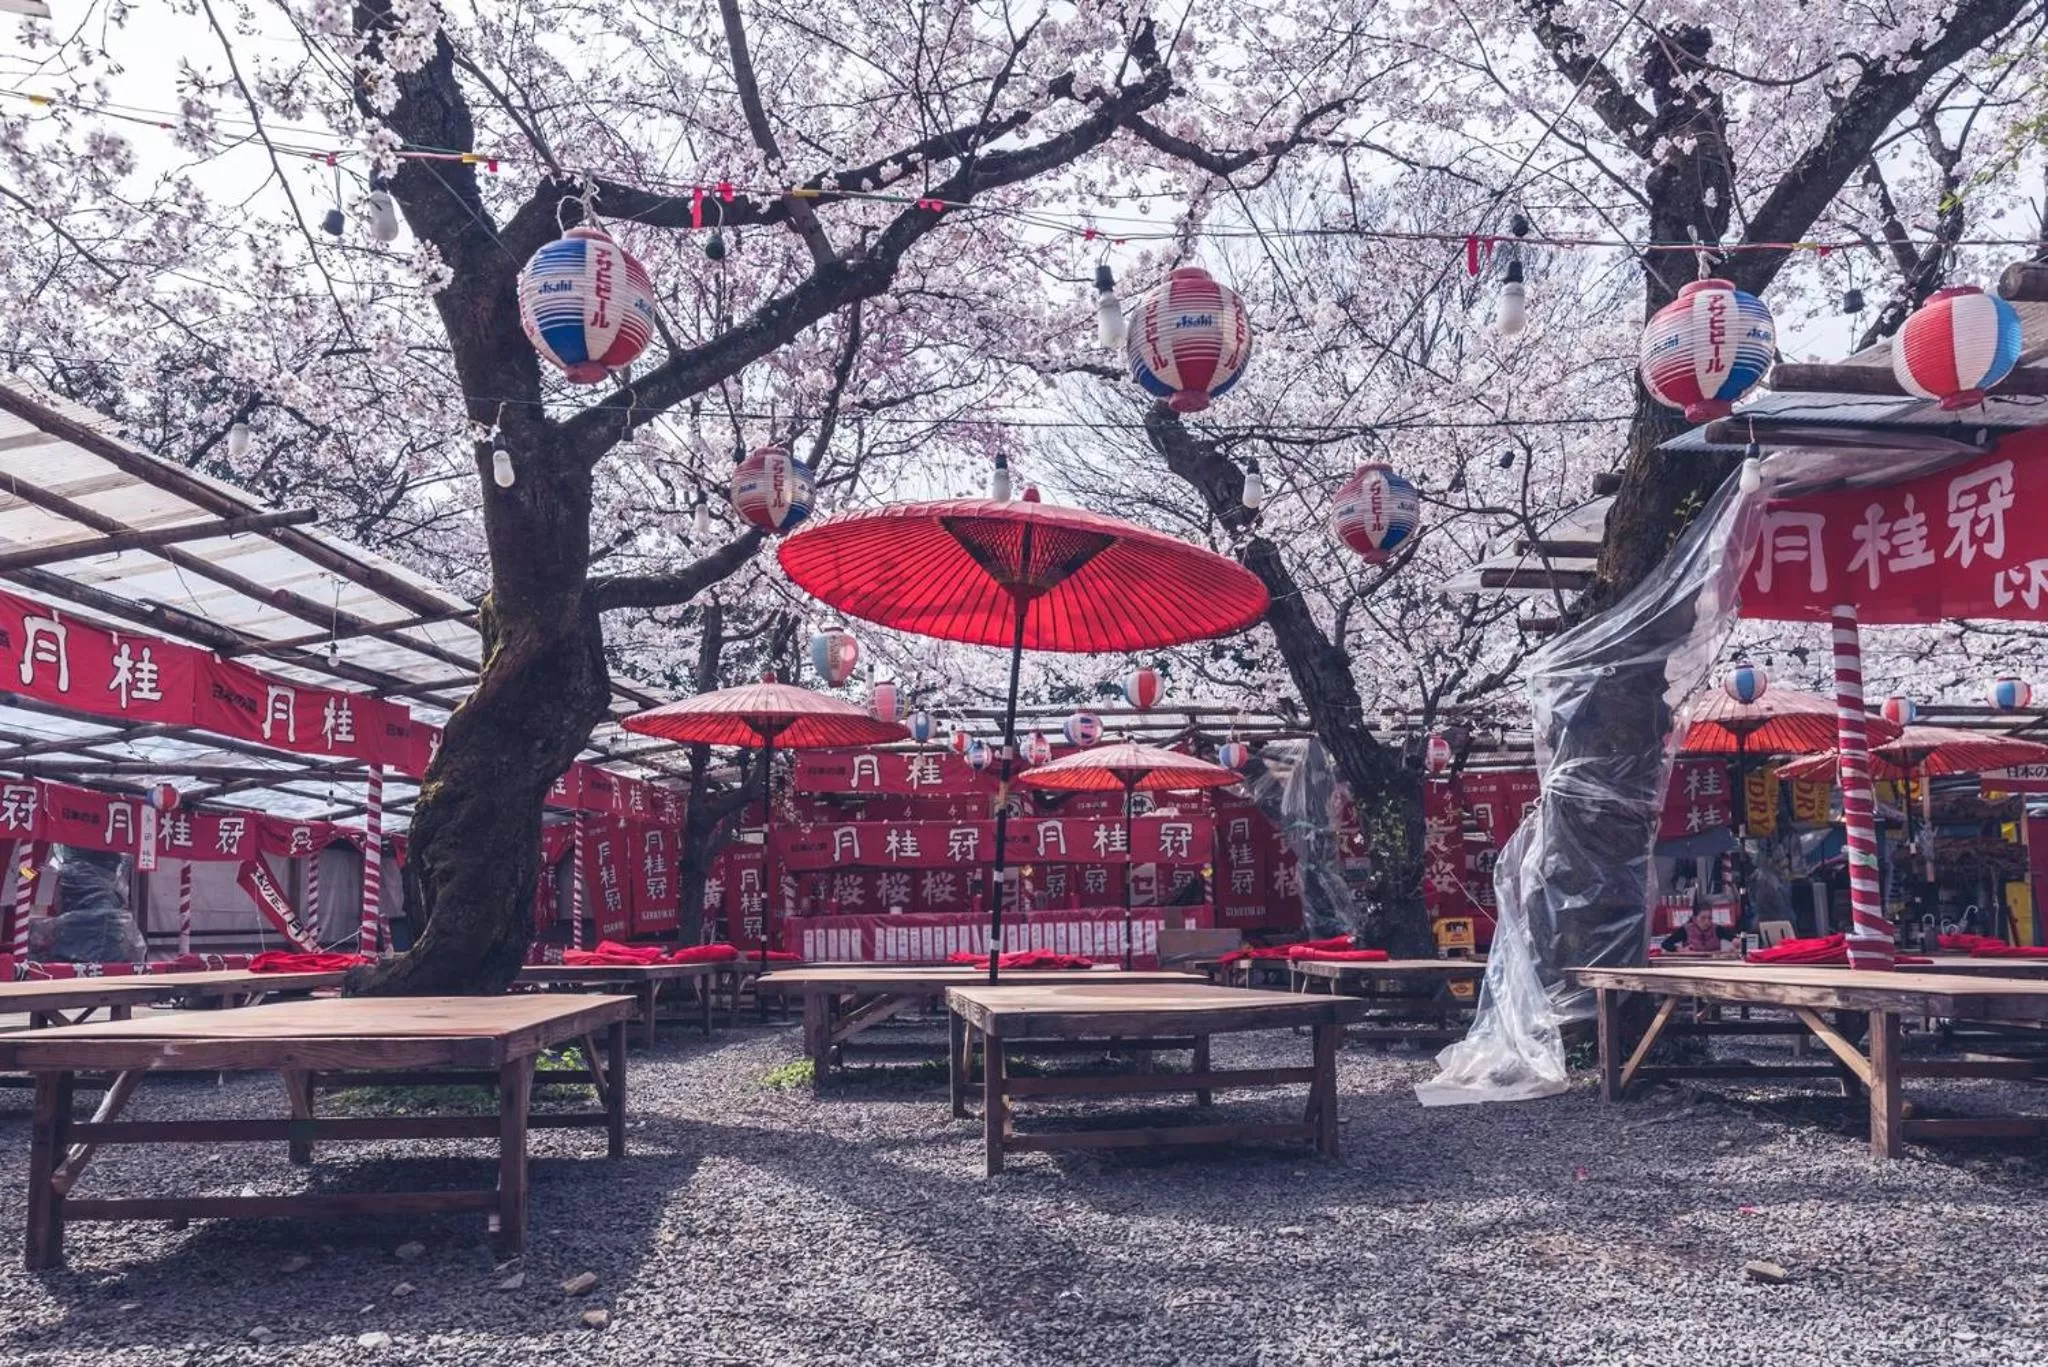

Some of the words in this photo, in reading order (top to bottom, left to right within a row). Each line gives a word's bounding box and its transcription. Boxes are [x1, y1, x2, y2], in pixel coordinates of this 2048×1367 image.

[538, 280, 573, 295] Asahi
[1176, 314, 1212, 328] Asahi
[1705, 294, 1727, 374] アサヒビール
[1754, 460, 2016, 594] 月桂冠
[20, 615, 163, 709] 月桂
[262, 684, 355, 750] 月桂
[851, 754, 942, 790] 月桂
[1684, 767, 1722, 800] 桂
[0, 784, 38, 831] 冠
[1796, 781, 1816, 820] DR
[105, 801, 245, 855] 月桂冠
[833, 826, 979, 862] 月桂冠
[1036, 820, 1193, 859] 月桂冠
[644, 830, 668, 900] 月桂冠
[1228, 818, 1255, 895] 月桂冠
[740, 868, 762, 939] 月桂冠
[875, 872, 912, 906] 桜
[921, 870, 957, 906] 桜
